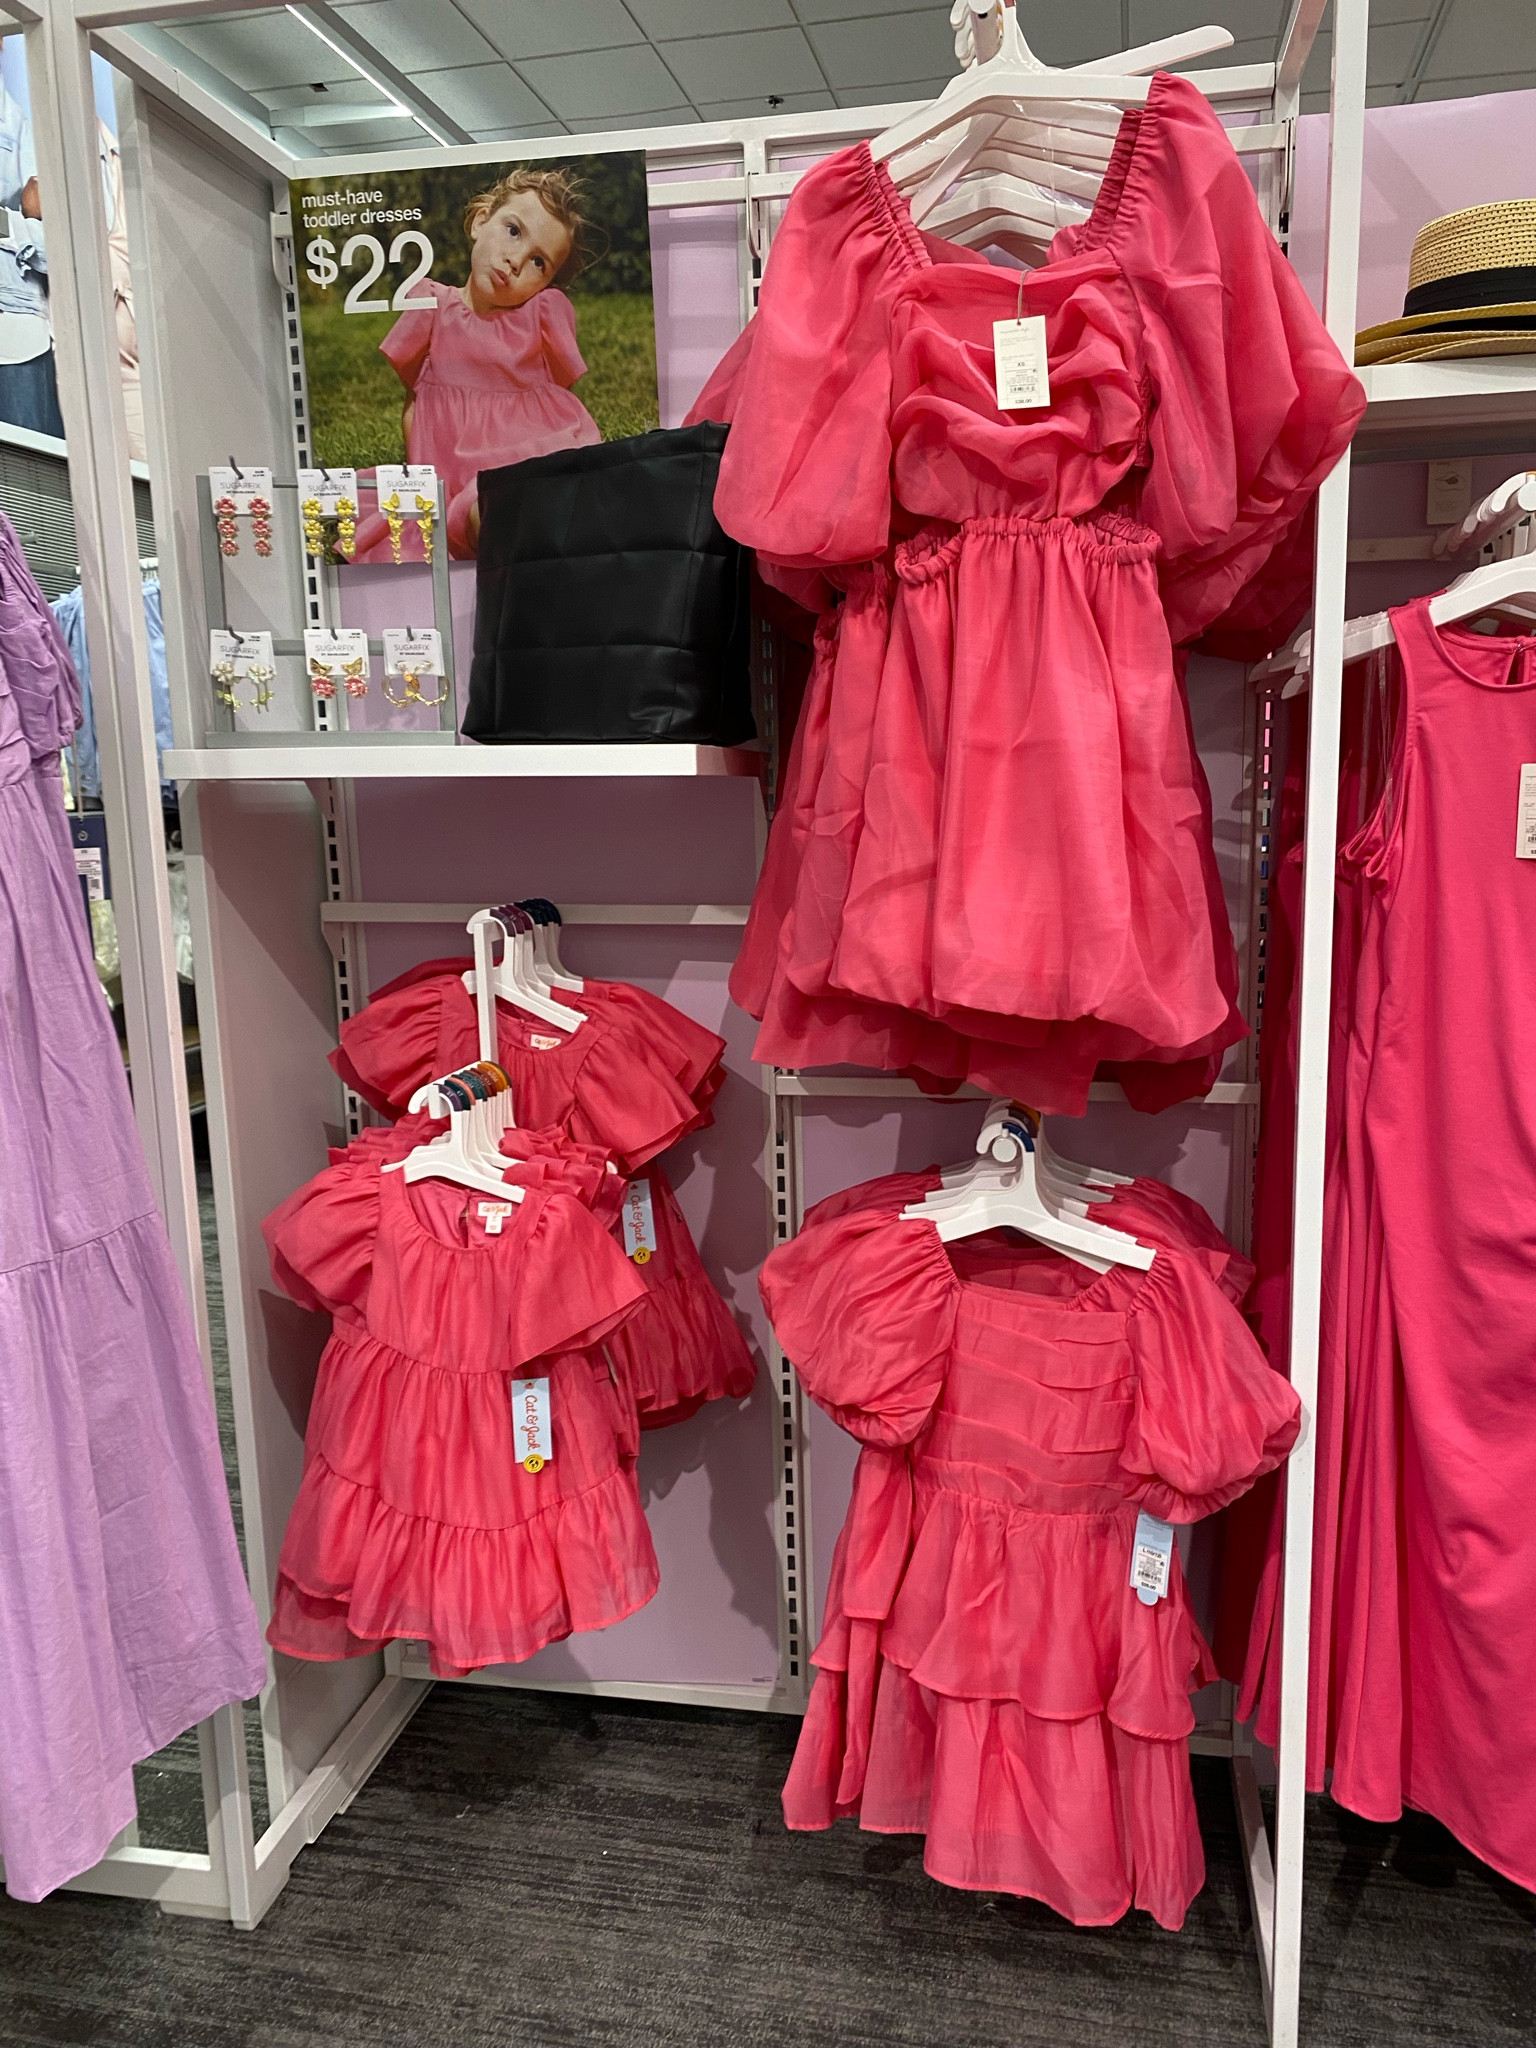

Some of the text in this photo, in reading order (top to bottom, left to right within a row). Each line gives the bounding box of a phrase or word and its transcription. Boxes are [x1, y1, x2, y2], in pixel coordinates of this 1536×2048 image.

[301, 189, 383, 208] must-have
[303, 208, 422, 228] toddler dresses
[306, 230, 438, 314] $22
[308, 484, 347, 492] SUGARFIX
[386, 480, 426, 488] SUGARFIX
[220, 645, 260, 655] SUGARFIX
[314, 644, 355, 652] SUGARFIX
[393, 644, 430, 652] SUGARFIX
[630, 1194, 640, 1211] Cat
[628, 1221, 646, 1244] Jack
[520, 1394, 541, 1451] Cat & Jack
